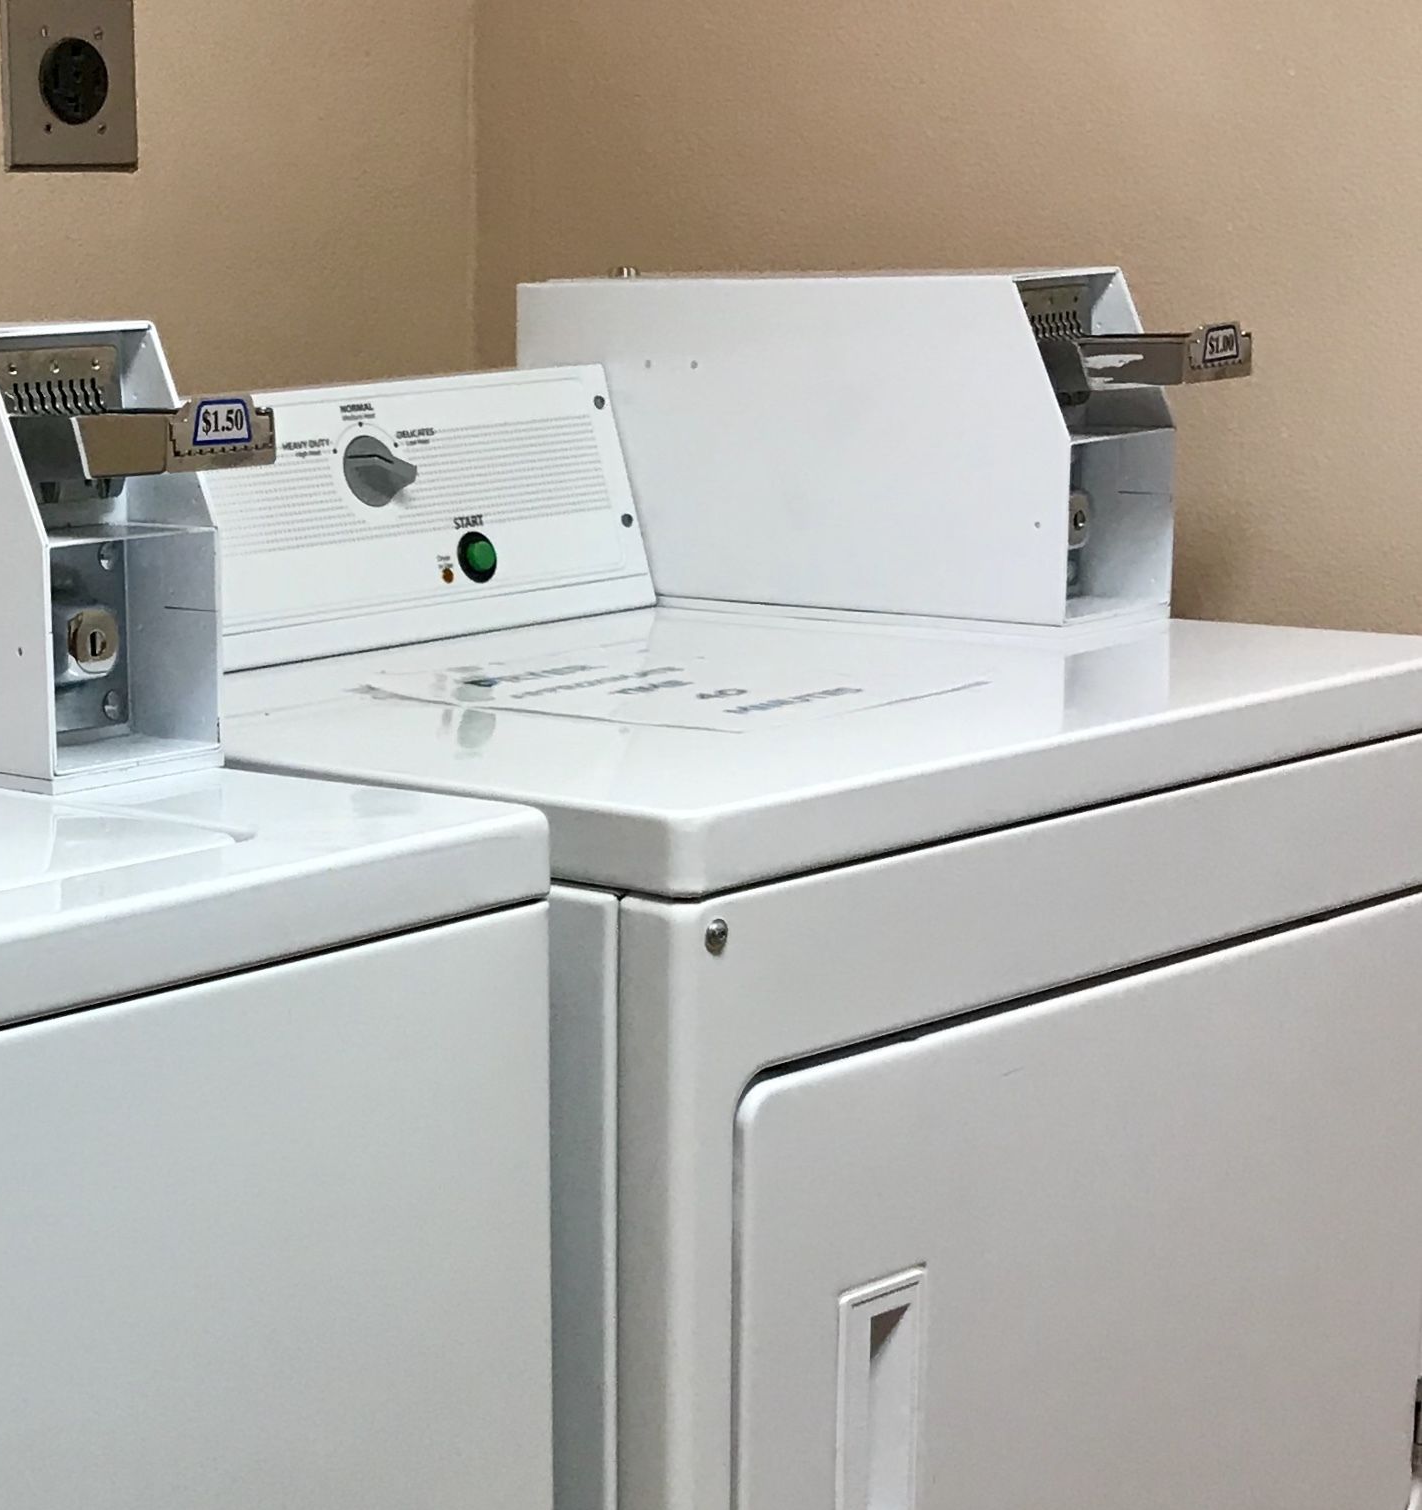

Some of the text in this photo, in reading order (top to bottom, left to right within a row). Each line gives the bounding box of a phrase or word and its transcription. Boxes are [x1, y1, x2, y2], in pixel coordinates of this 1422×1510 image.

[340, 403, 374, 413] NORMAL
[201, 408, 244, 436] $1.50
[308, 438, 330, 448] DUTY
[453, 514, 484, 530] START
